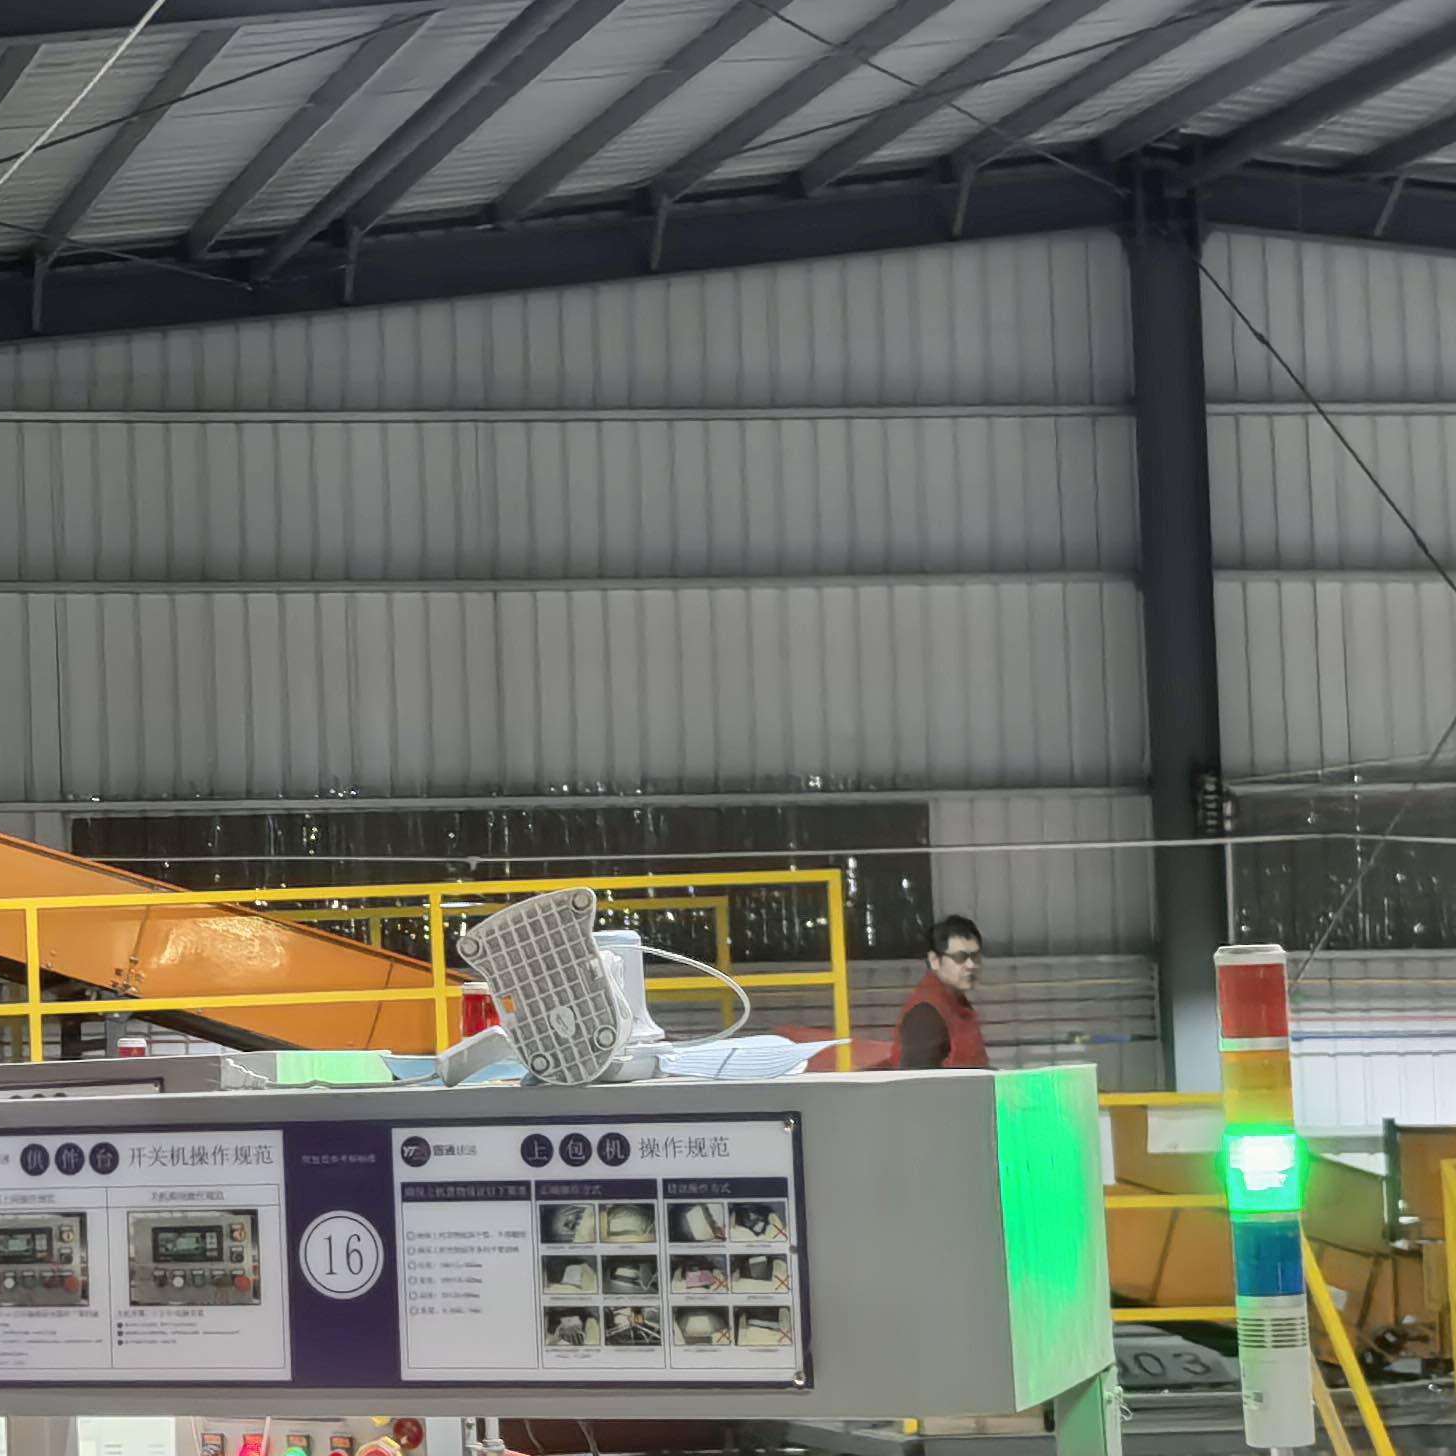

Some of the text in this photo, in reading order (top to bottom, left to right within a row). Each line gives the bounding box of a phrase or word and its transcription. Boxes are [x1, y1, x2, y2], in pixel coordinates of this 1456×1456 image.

[128, 1145, 274, 1169] 开关机操作规范
[639, 1136, 730, 1160] 操作规范
[323, 1233, 364, 1276] 16
